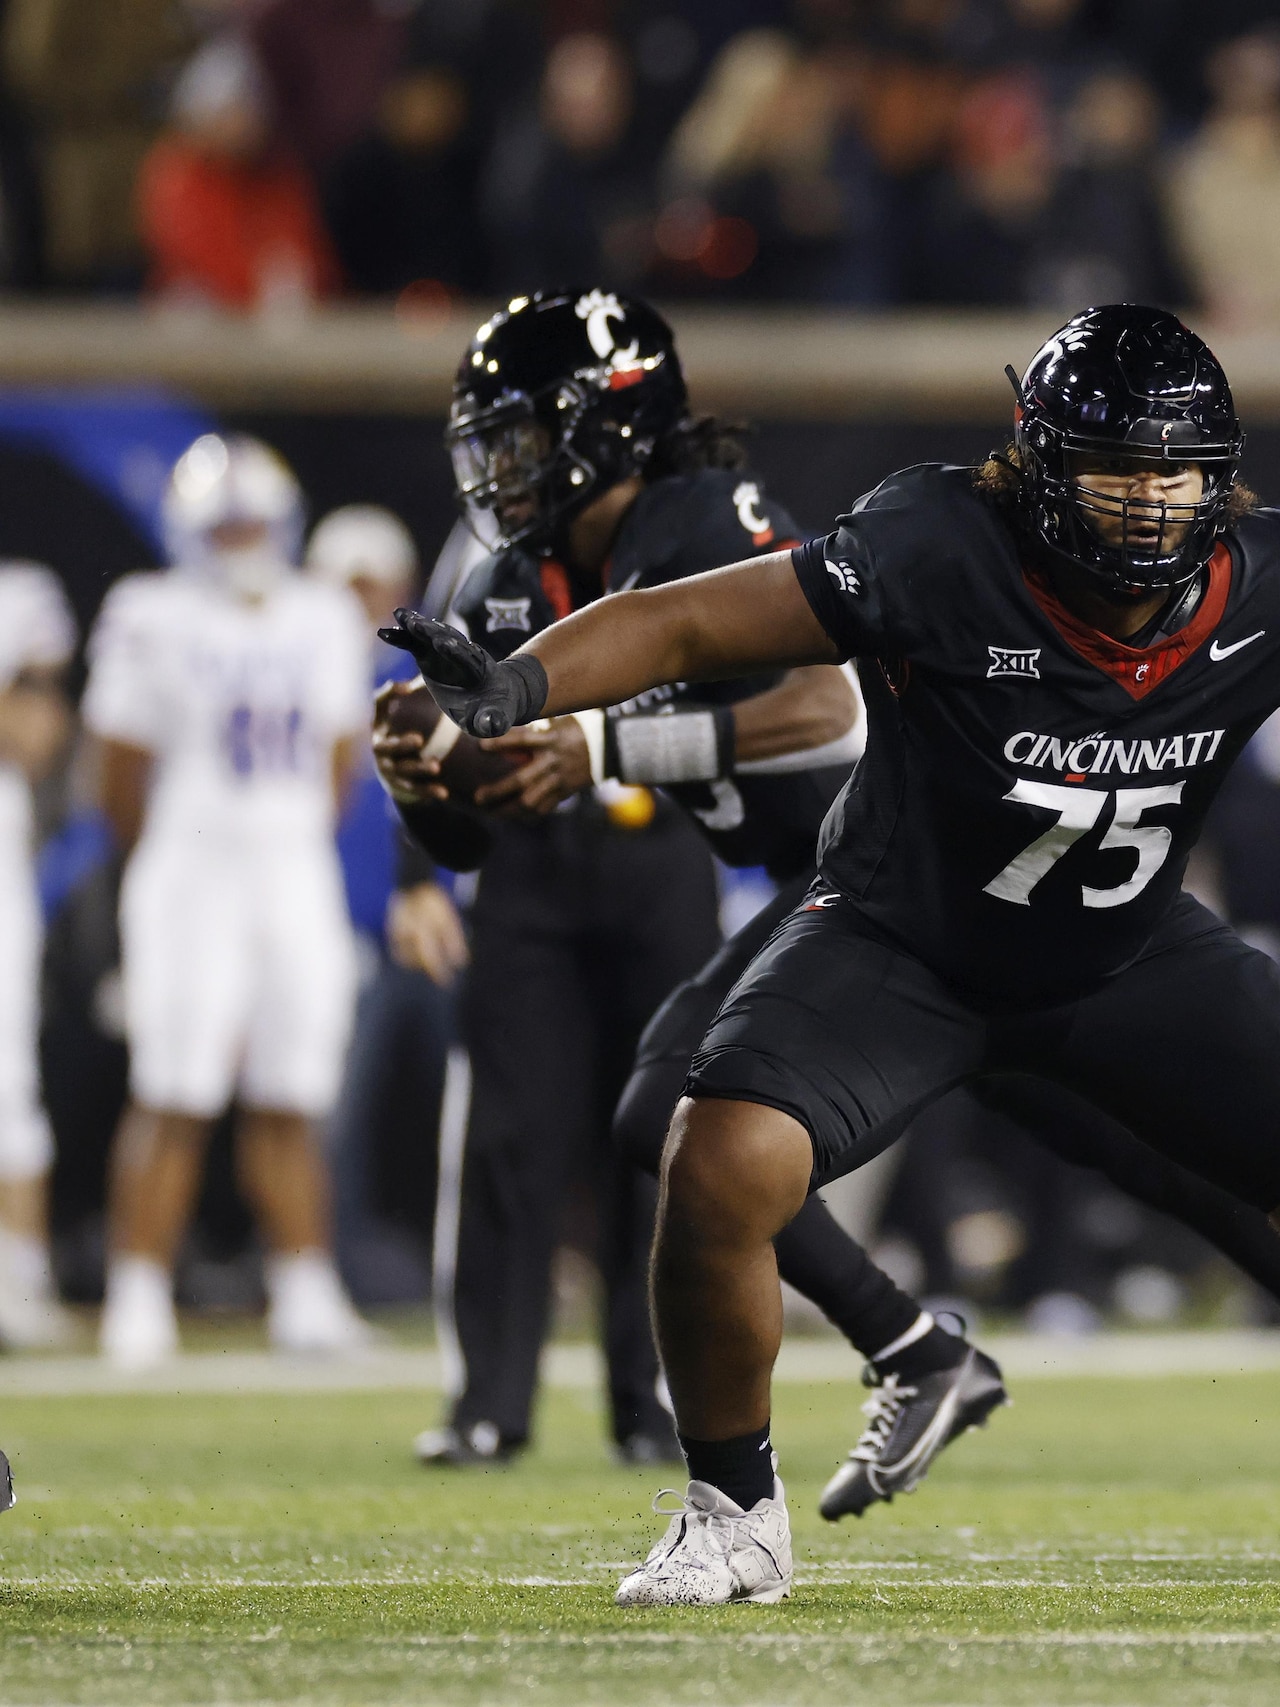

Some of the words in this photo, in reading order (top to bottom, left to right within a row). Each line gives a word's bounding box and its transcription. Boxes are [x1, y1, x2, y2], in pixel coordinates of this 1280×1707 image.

[994, 651, 1033, 674] XII
[1003, 729, 1227, 775] CINCINNATI
[982, 778, 1187, 908] 75
